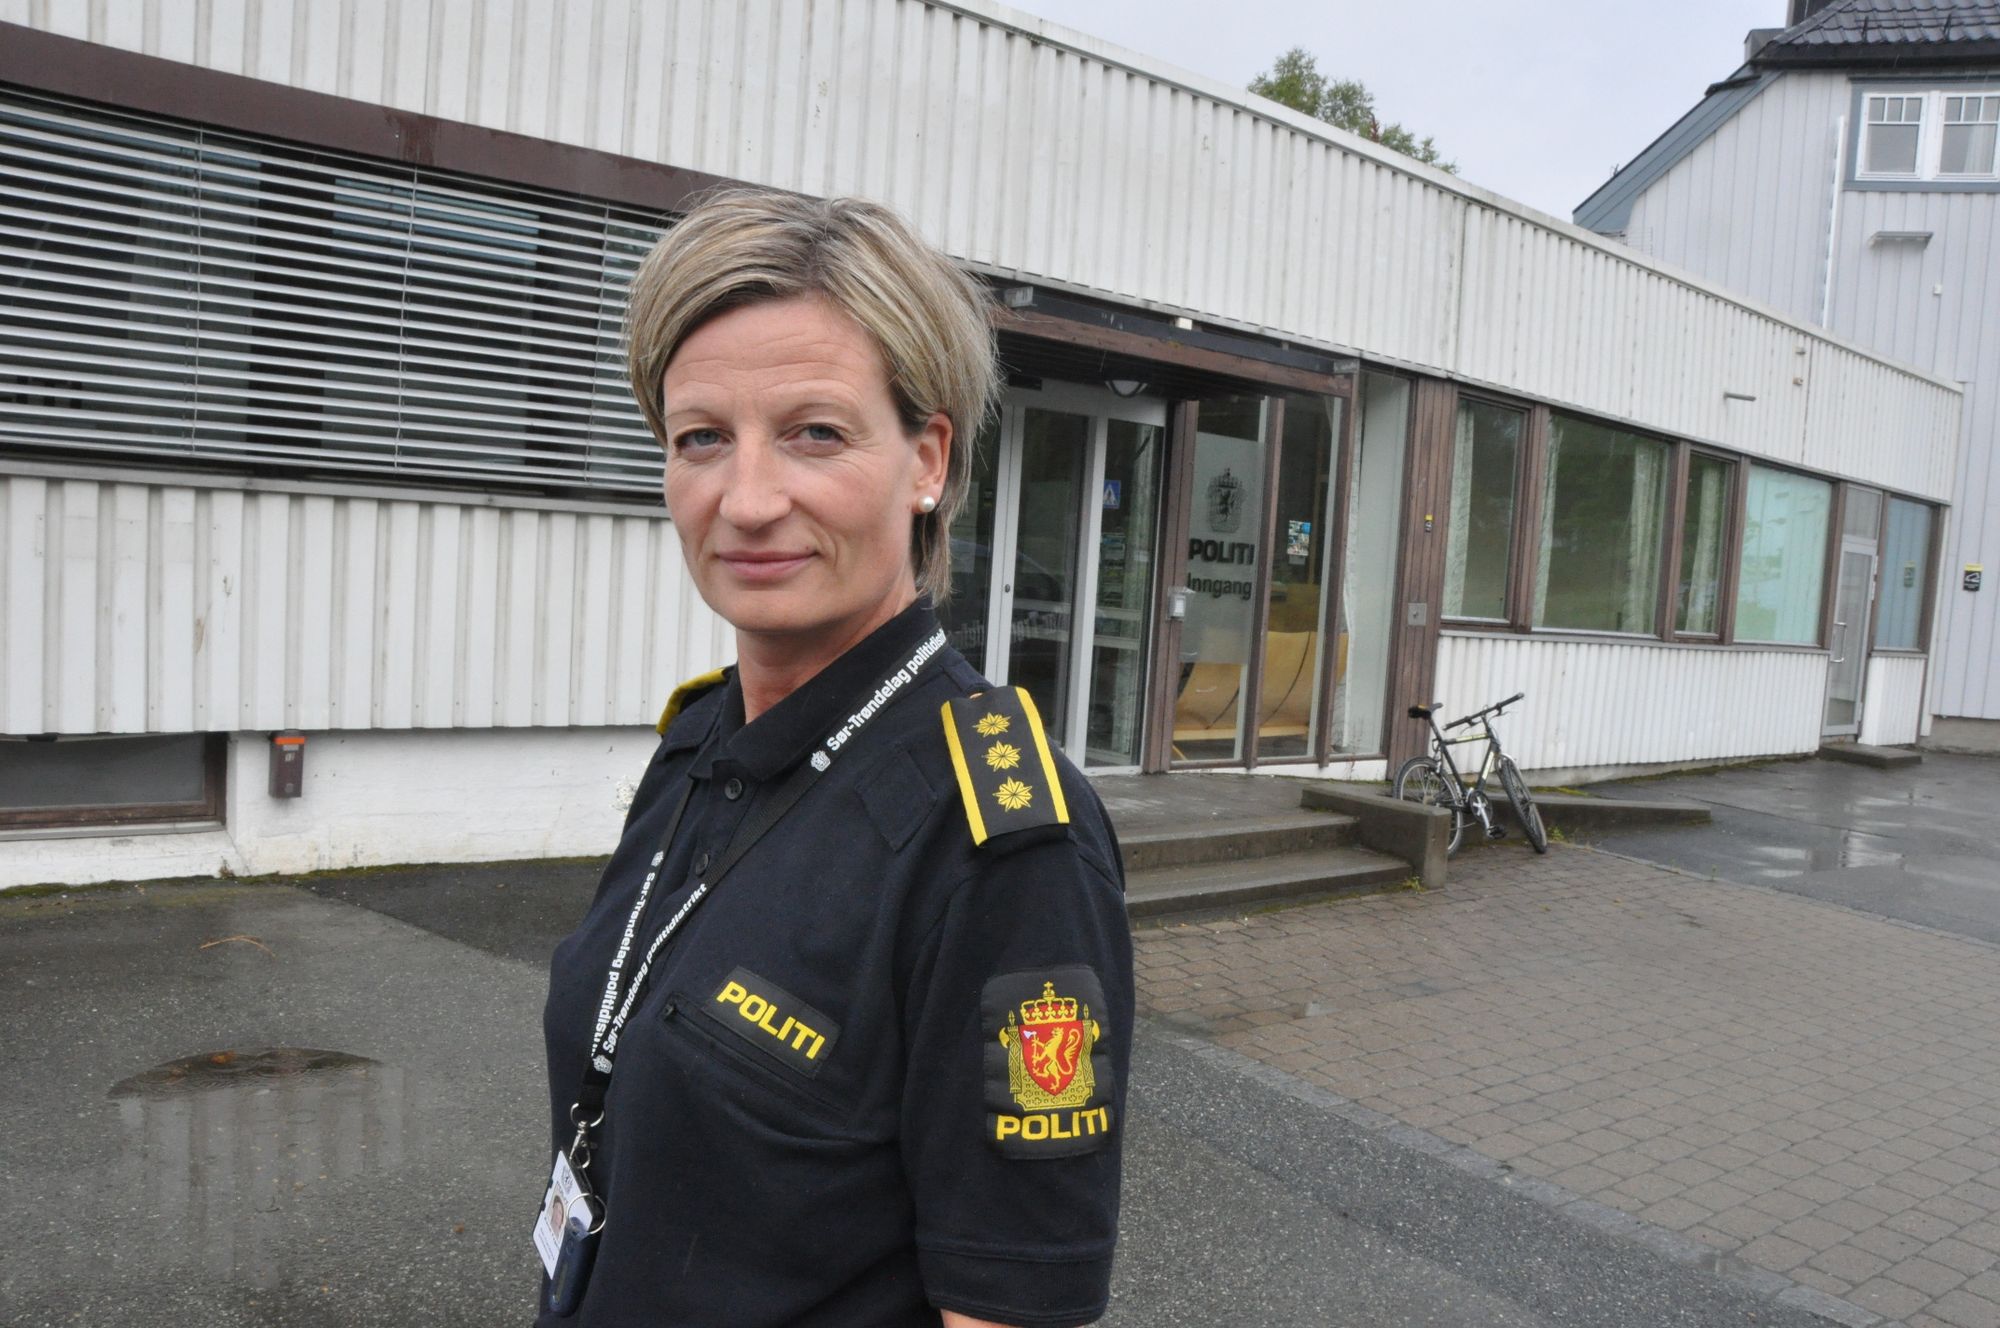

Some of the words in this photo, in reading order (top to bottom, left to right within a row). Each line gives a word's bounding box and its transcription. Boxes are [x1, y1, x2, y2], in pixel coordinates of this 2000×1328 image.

[1187, 572, 1252, 601] Inngang
[1188, 538, 1255, 565] POLITI
[826, 668, 912, 751] Sør-Trøndelag
[612, 872, 655, 968] Sør-Trøndelag
[603, 962, 648, 1053] Sør-Trøndelag
[646, 883, 707, 964] politidistrikt
[716, 981, 825, 1059] POLITI
[996, 1107, 1108, 1140] POLITI
